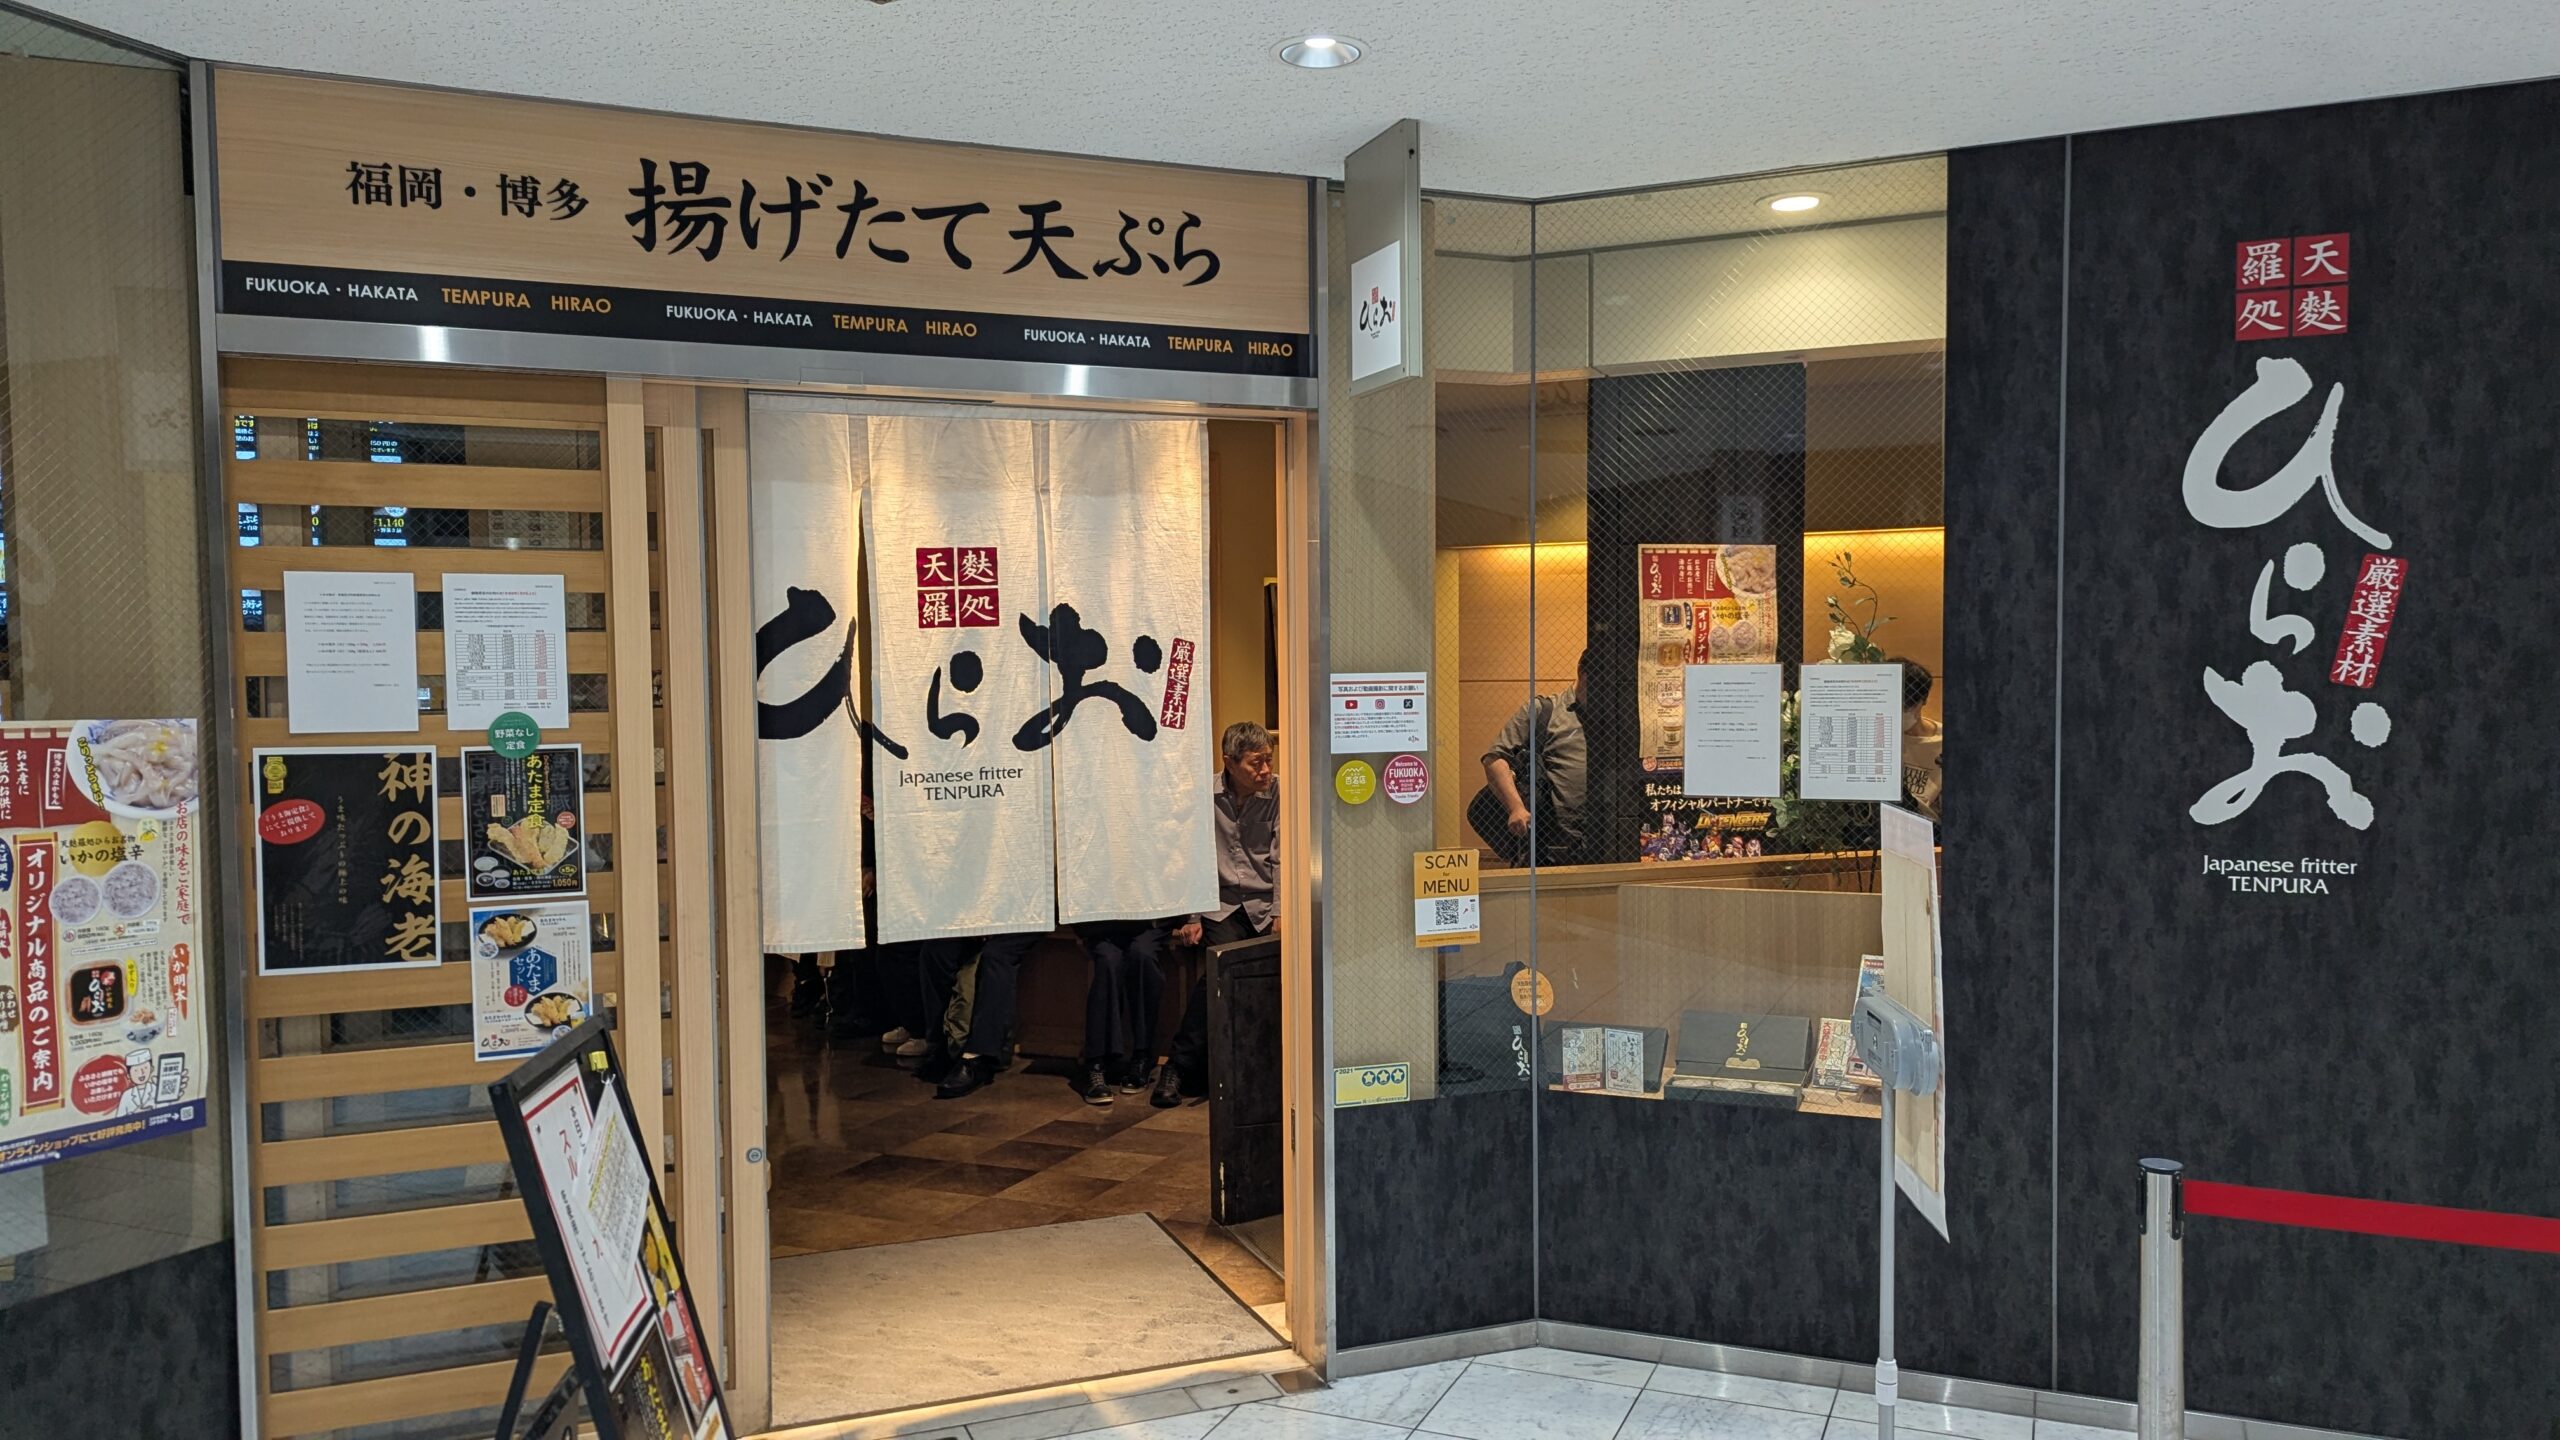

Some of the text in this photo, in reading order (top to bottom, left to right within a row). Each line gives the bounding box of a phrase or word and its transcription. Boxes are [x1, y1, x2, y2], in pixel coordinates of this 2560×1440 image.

[345, 157, 1220, 287] 福岡・博多 揚げたて天ぷら
[245, 277, 330, 295] FUKUOKA
[348, 284, 419, 301] HAKATA
[441, 288, 531, 308] TEMPURA
[551, 295, 612, 314] HIRAO
[666, 305, 738, 322] FUKUOKA
[753, 311, 813, 327] HAKATA
[832, 314, 909, 333] TEMPURA
[925, 320, 977, 337] HIRAO
[1024, 329, 1086, 344] FUKUOKA
[1099, 334, 1151, 348] HAKATA
[1168, 336, 1233, 353] TEMPURA
[1248, 341, 1293, 357] HIRAO
[2182, 357, 2393, 830] ひらお
[2336, 558, 2400, 686] 厳選素材
[756, 586, 1162, 760] ひらお
[1162, 641, 1194, 728] 厳選素材
[495, 729, 534, 739] 野菜なし
[506, 741, 527, 750] 定食
[16, 749, 29, 796] お土産に
[527, 754, 545, 830] あたま定食
[900, 765, 1024, 787] Japanese fritter
[924, 783, 1005, 800] TENPURA
[1389, 768, 1424, 778] FUKUOKA
[1645, 784, 1682, 796] 私たちは
[60, 844, 144, 865] いかの塩辛
[176, 803, 191, 925] お店の味をご家庭で
[378, 752, 434, 962] 神の海老
[1425, 854, 1468, 870] SCAN
[2203, 854, 2358, 877] Japanese fritter
[1423, 878, 1470, 895] MENU
[2228, 876, 2329, 895] TENPURA
[25, 848, 53, 1092] オリジナル商品のご案内
[173, 947, 186, 1001] いか明太
[514, 957, 524, 984] セット
[526, 949, 542, 992] あたま
